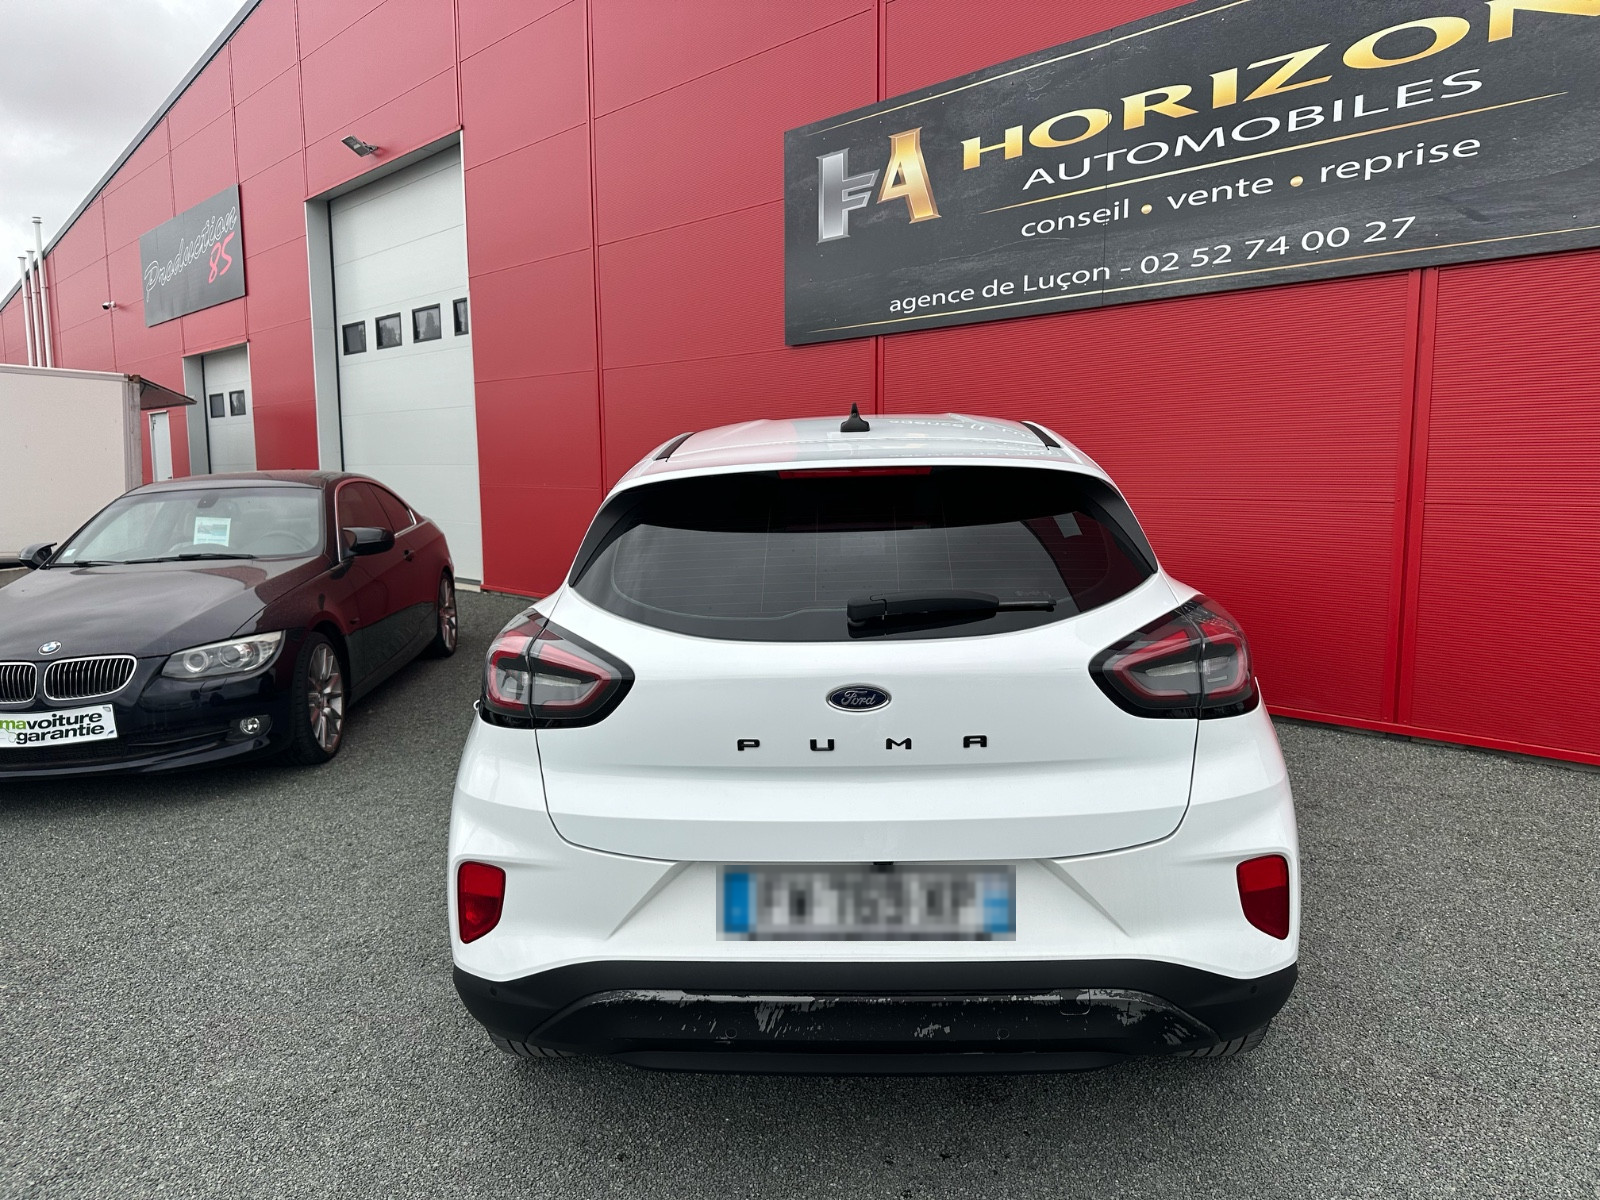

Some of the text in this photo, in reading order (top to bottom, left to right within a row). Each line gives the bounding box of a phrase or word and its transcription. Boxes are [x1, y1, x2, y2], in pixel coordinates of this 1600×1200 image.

[1022, 68, 1483, 191] AUTOMOBILES
[1021, 138, 1481, 237] conseil vente reprise
[144, 206, 238, 303] Production
[208, 231, 235, 284] 85
[889, 288, 975, 314] agence
[982, 279, 1015, 298] de
[1023, 266, 1110, 292] Luçon
[1140, 253, 1179, 274] 02
[1190, 244, 1232, 268] 52
[1245, 236, 1290, 260] 74
[1301, 227, 1350, 252] 00
[1363, 216, 1416, 244] 27
[16, 723, 105, 745] garantie
[841, 690, 876, 705] Ford
[737, 735, 988, 751] PUMA
